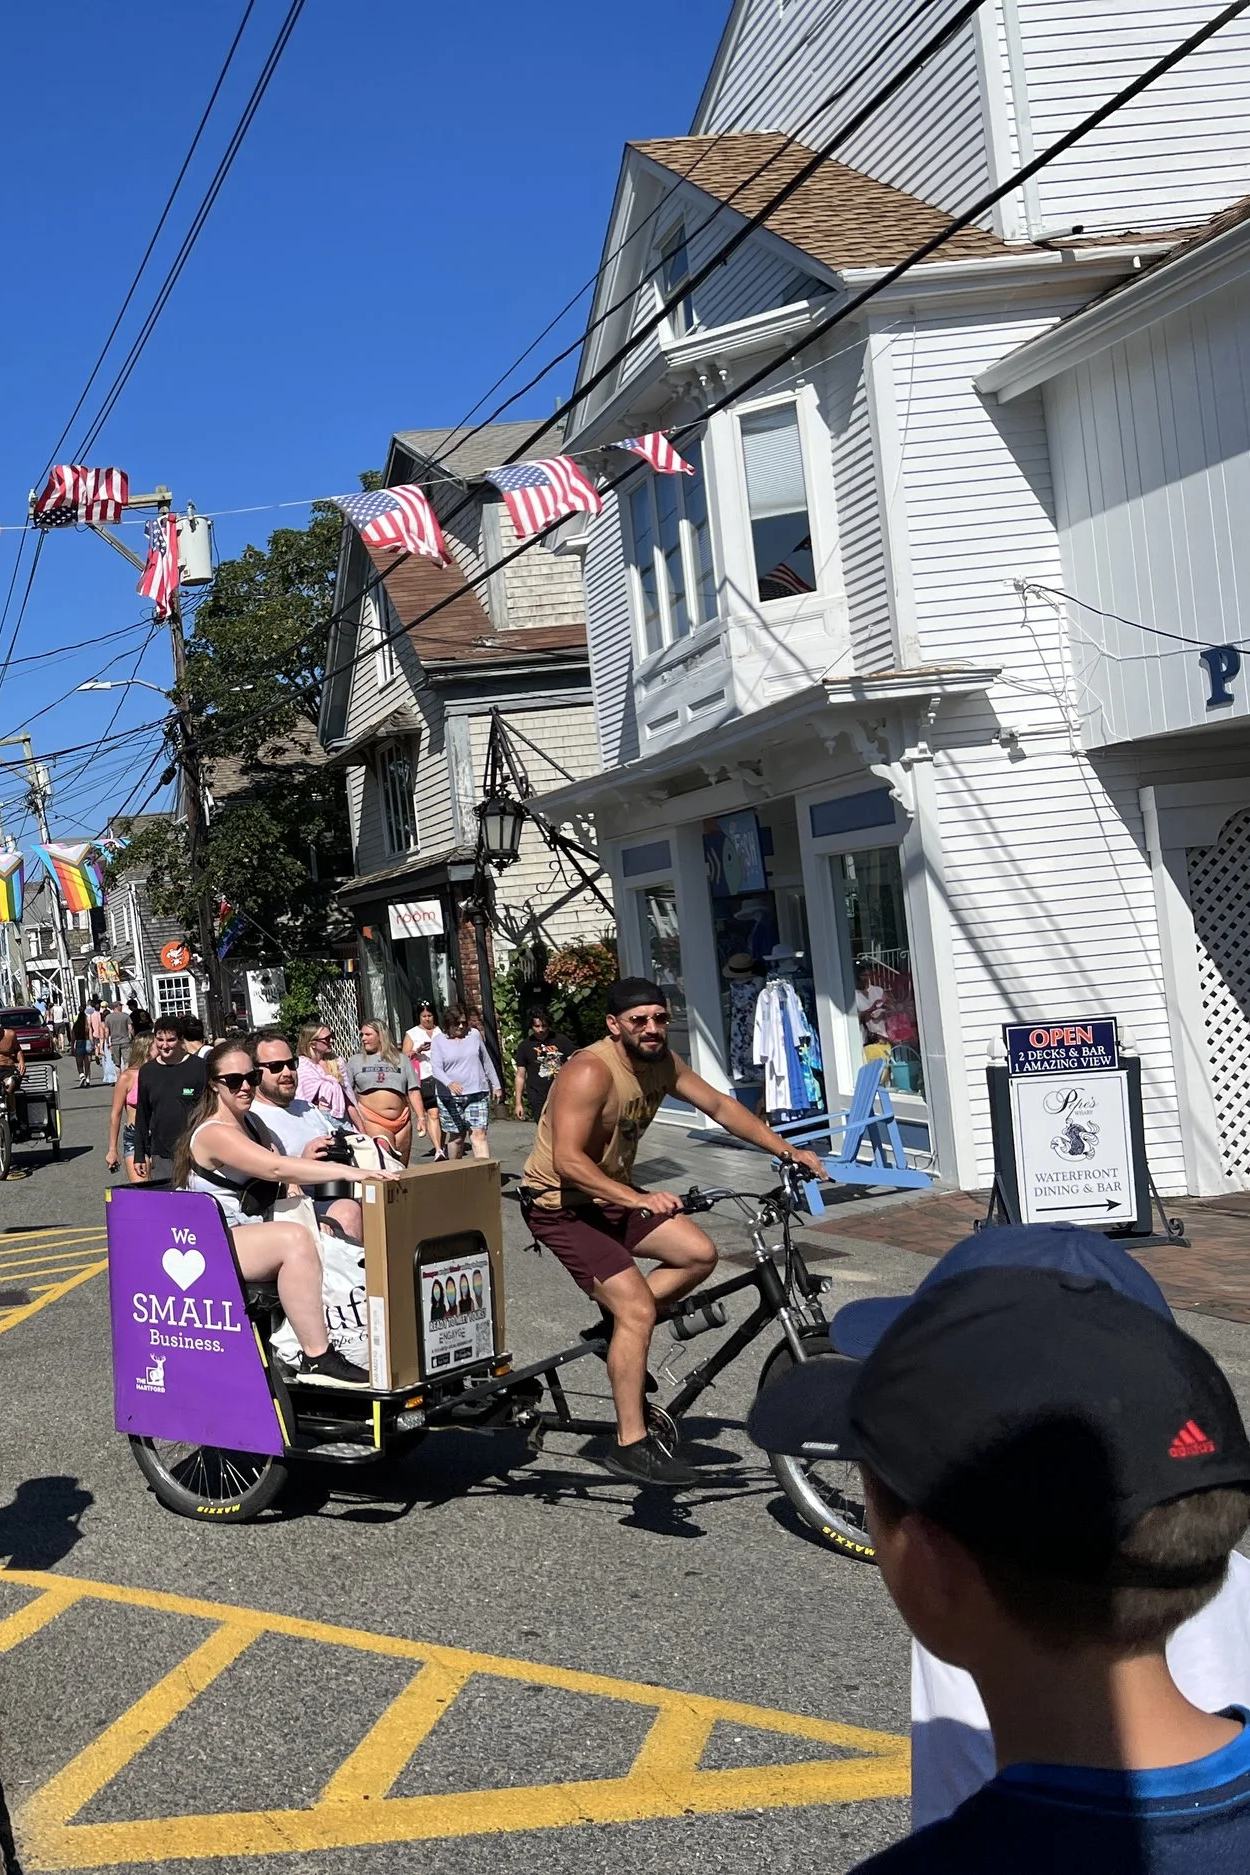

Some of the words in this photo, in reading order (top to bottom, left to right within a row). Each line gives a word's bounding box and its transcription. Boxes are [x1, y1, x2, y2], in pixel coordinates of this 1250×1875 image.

[1199, 644, 1240, 709] P
[1029, 1025, 1093, 1048] OPEN
[1018, 1051, 1025, 1061] 2
[1028, 1048, 1065, 1060] DECKS
[1069, 1047, 1079, 1057] &
[1082, 1045, 1106, 1056] BAR
[1015, 1063, 1020, 1072] 1
[1023, 1058, 1078, 1072] AMAZING
[1080, 1055, 1111, 1067] VIEW
[1043, 1087, 1096, 1120] Pepe's
[1035, 1168, 1118, 1182] WATERFRONT
[1034, 1184, 1079, 1197] DINING
[1083, 1183, 1094, 1193] &
[1097, 1181, 1122, 1193] BAR
[171, 1227, 197, 1245] We
[132, 1292, 241, 1332] SMALL
[150, 1328, 225, 1352] Business.
[136, 1383, 166, 1393] HARTFORD
[822, 1526, 876, 1556] MAXXIS
